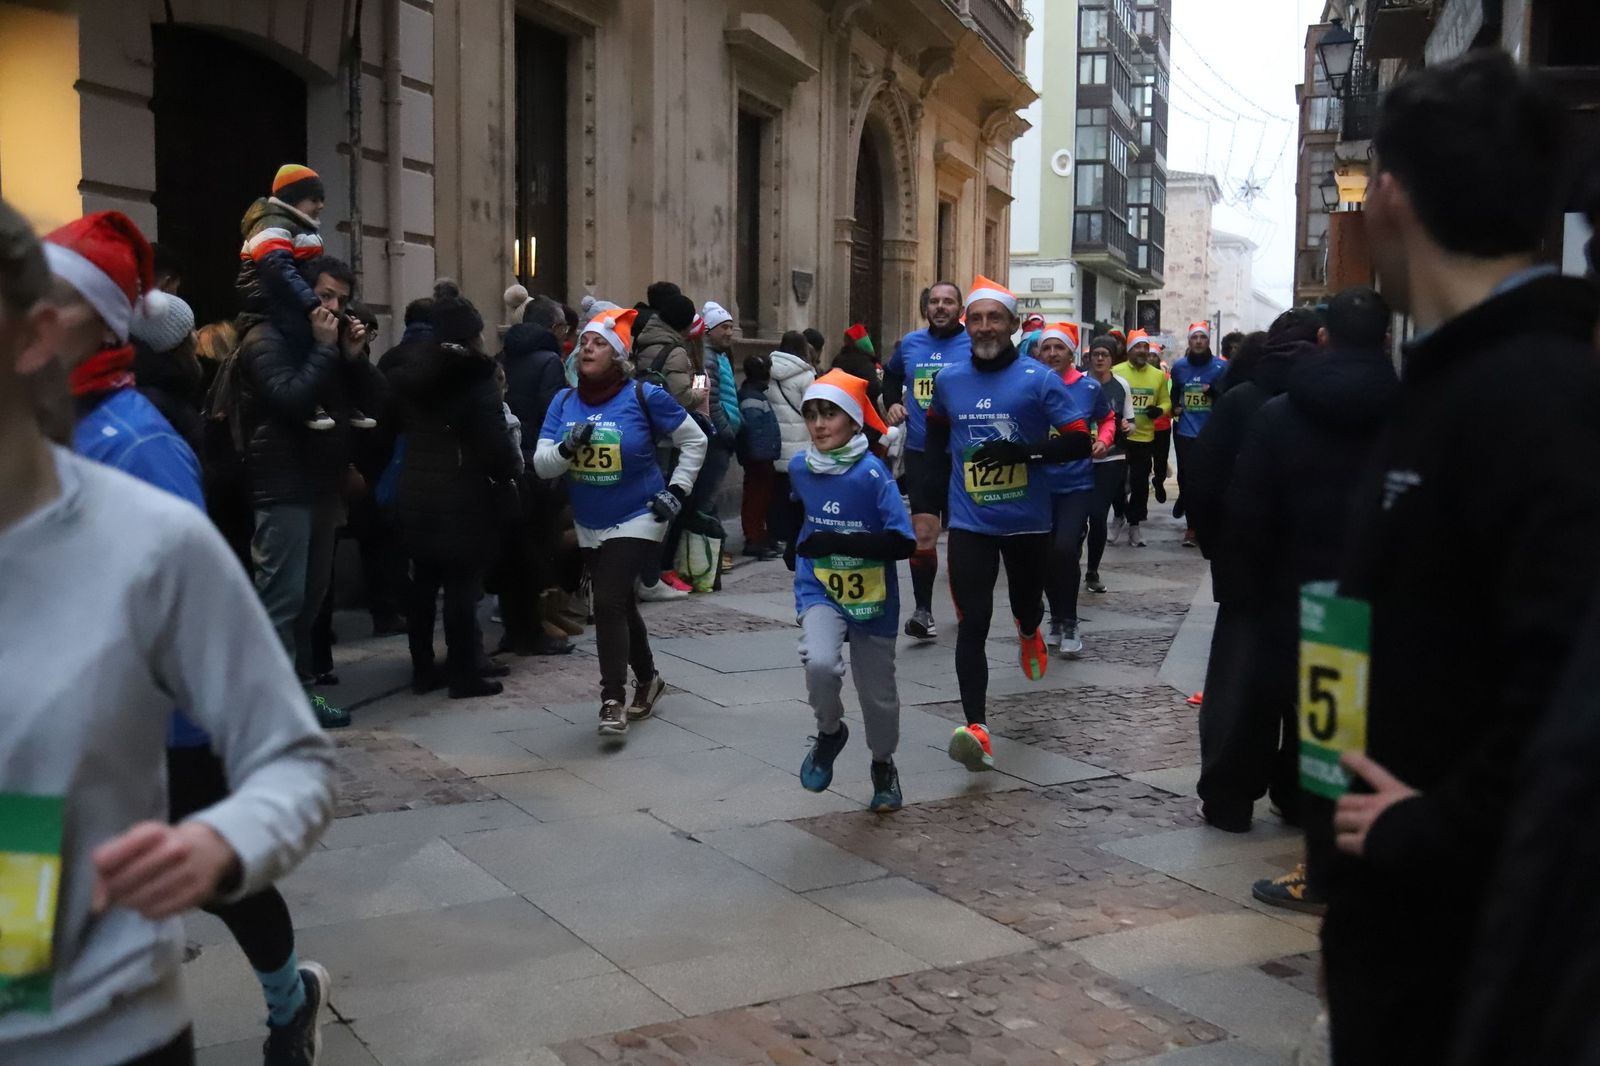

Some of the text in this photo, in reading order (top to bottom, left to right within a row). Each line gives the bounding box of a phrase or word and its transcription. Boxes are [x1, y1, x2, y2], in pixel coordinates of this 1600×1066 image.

[930, 352, 942, 361] 46
[976, 398, 992, 409] 46
[1132, 395, 1149, 406] 217
[1186, 395, 1208, 405] 759
[586, 413, 603, 421] 46
[822, 500, 840, 514] 46
[828, 573, 865, 600] 93
